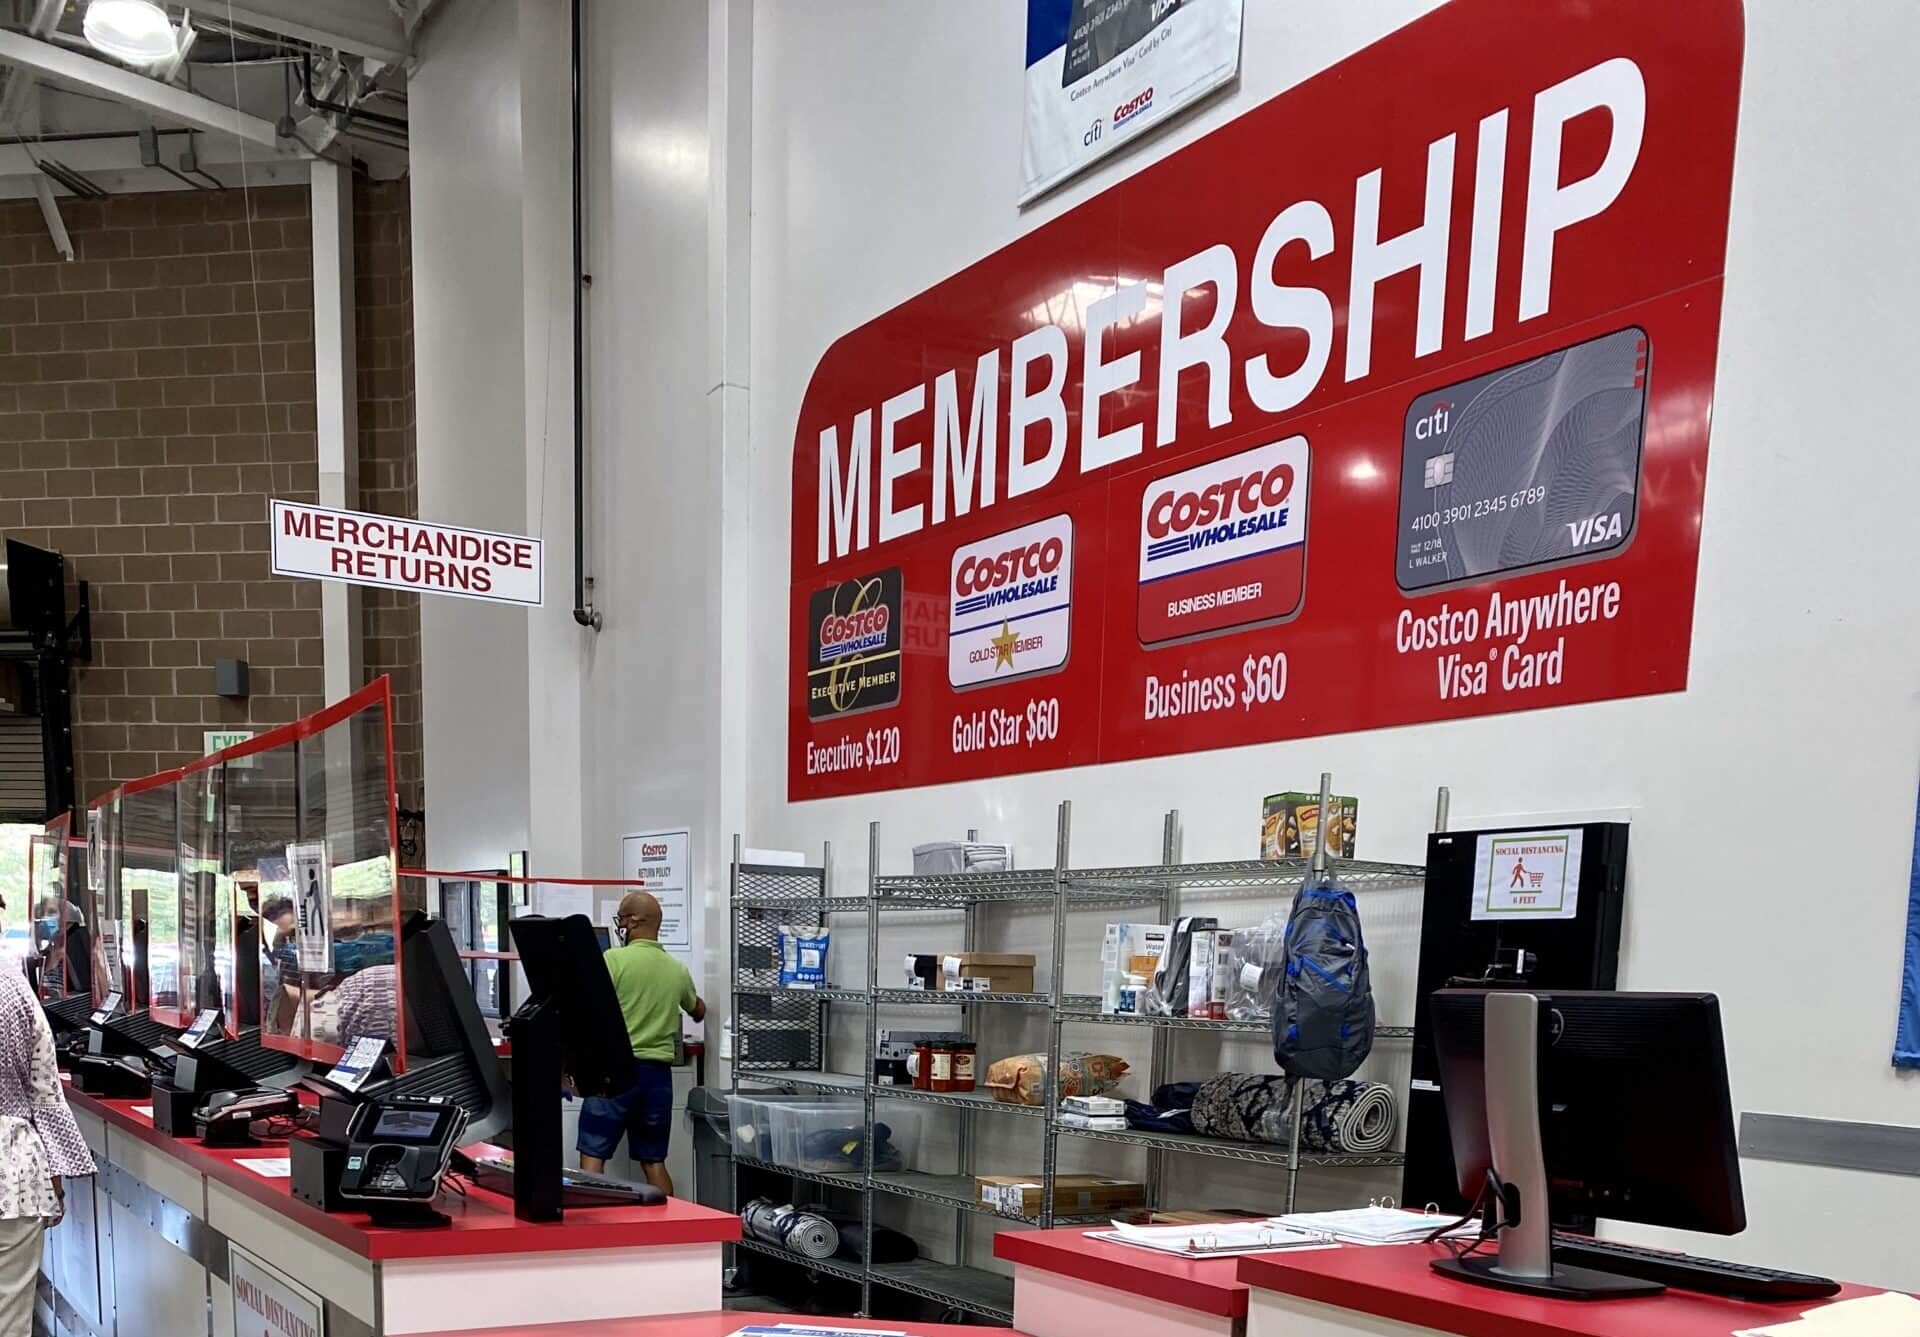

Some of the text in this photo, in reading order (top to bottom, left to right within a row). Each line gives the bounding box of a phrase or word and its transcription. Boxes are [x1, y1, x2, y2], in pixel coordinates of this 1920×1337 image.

[1151, 0, 1177, 22] VIS
[1070, 85, 1092, 101] Costco
[1113, 86, 1154, 122] COSTCO
[1084, 119, 1102, 147] citi
[816, 56, 1647, 566] MEMBERSHIP
[1415, 403, 1449, 440] citi
[1146, 463, 1295, 540] COSTCO
[1412, 485, 1546, 532] 4100 3901 2345 6789
[284, 510, 533, 569] MERCHANDISE
[1188, 508, 1289, 550] WHOLESALE
[1566, 512, 1623, 548] VISA
[331, 547, 492, 592] RETURNS
[955, 537, 1064, 597] COSTCO
[1415, 552, 1448, 567] WALKER
[985, 575, 1059, 609] WHOLESALE
[1168, 582, 1262, 618] BUSINESS MEMBER
[820, 604, 889, 646] COSTCO
[1396, 579, 1621, 654] Costco Anywhere
[840, 632, 886, 655] WHOLESALE
[969, 646, 989, 664] GOLD
[1009, 636, 1043, 655] MEMBER
[1501, 637, 1566, 691] Card
[812, 672, 896, 699] EXECUTIVE MEMBER
[1144, 652, 1288, 720] Business $60
[952, 698, 1059, 753] Gold Star $60
[807, 727, 900, 775] Executive $120
[642, 843, 668, 856] COSTCO
[1495, 845, 1564, 856] SOCIAL DISTANCING
[235, 1274, 265, 1317] SOCIAL
